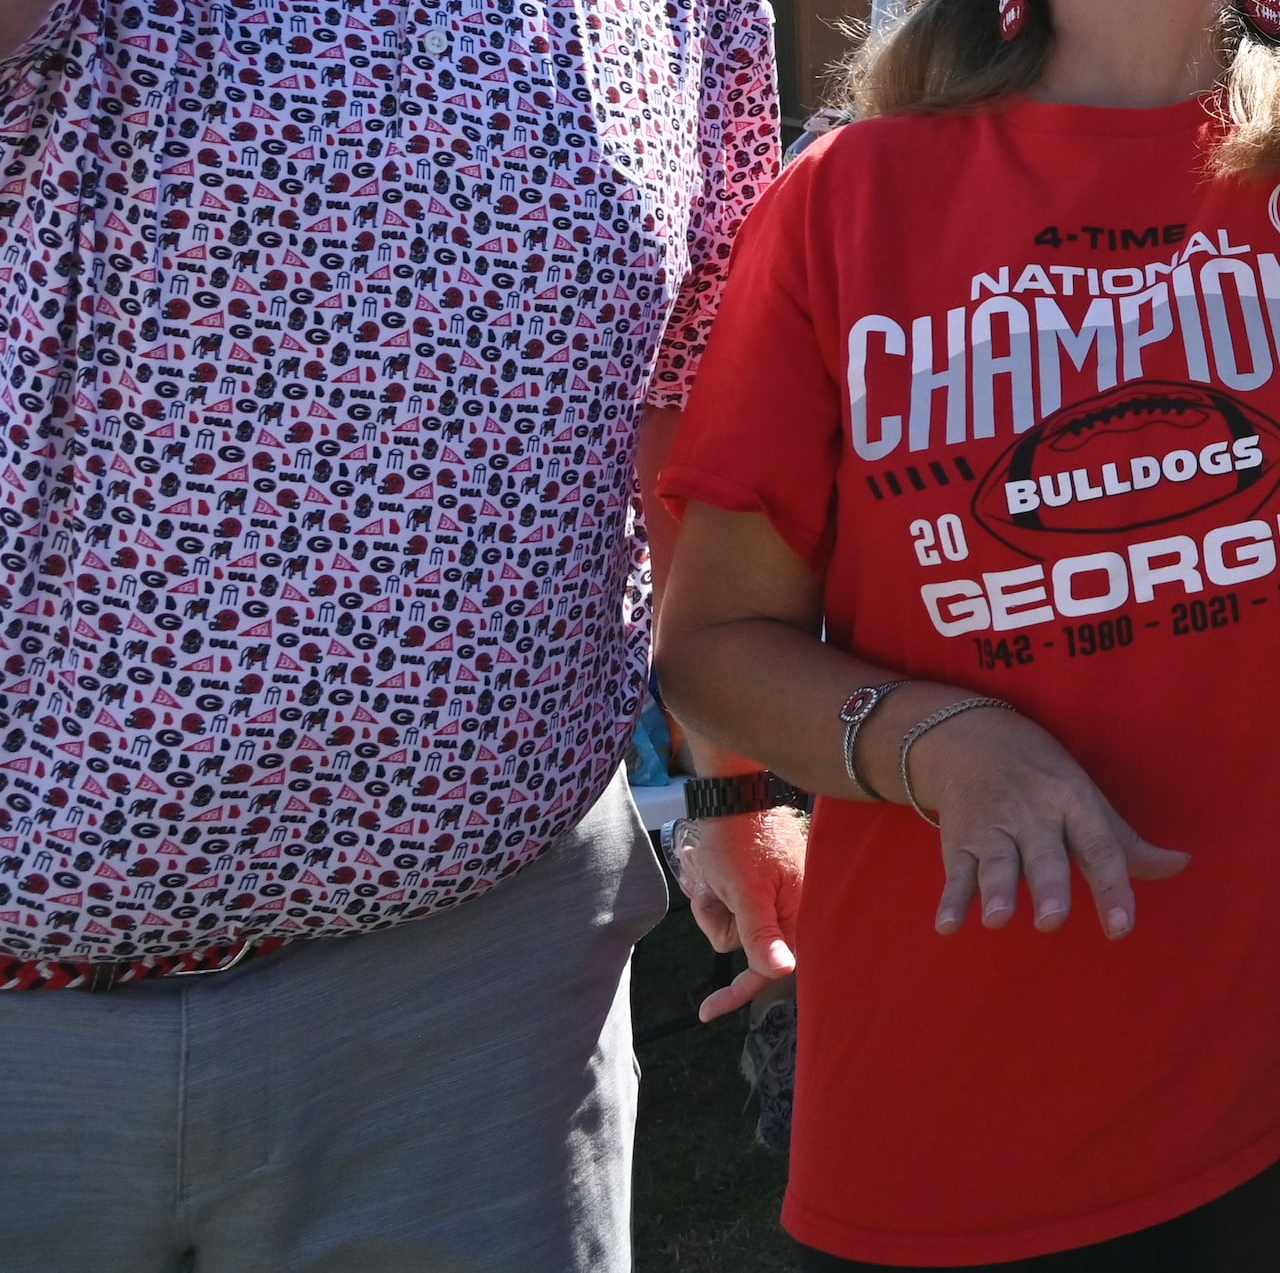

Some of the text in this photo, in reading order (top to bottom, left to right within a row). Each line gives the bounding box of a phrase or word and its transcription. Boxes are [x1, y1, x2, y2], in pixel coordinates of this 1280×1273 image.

[970, 229, 1251, 301] NATIONAL
[1034, 224, 1187, 251] 4-TIME
[1003, 434, 1264, 515] BULLDOGS
[909, 513, 970, 567] 20
[1063, 614, 1134, 658] 1980
[1171, 592, 1241, 635] 2021
